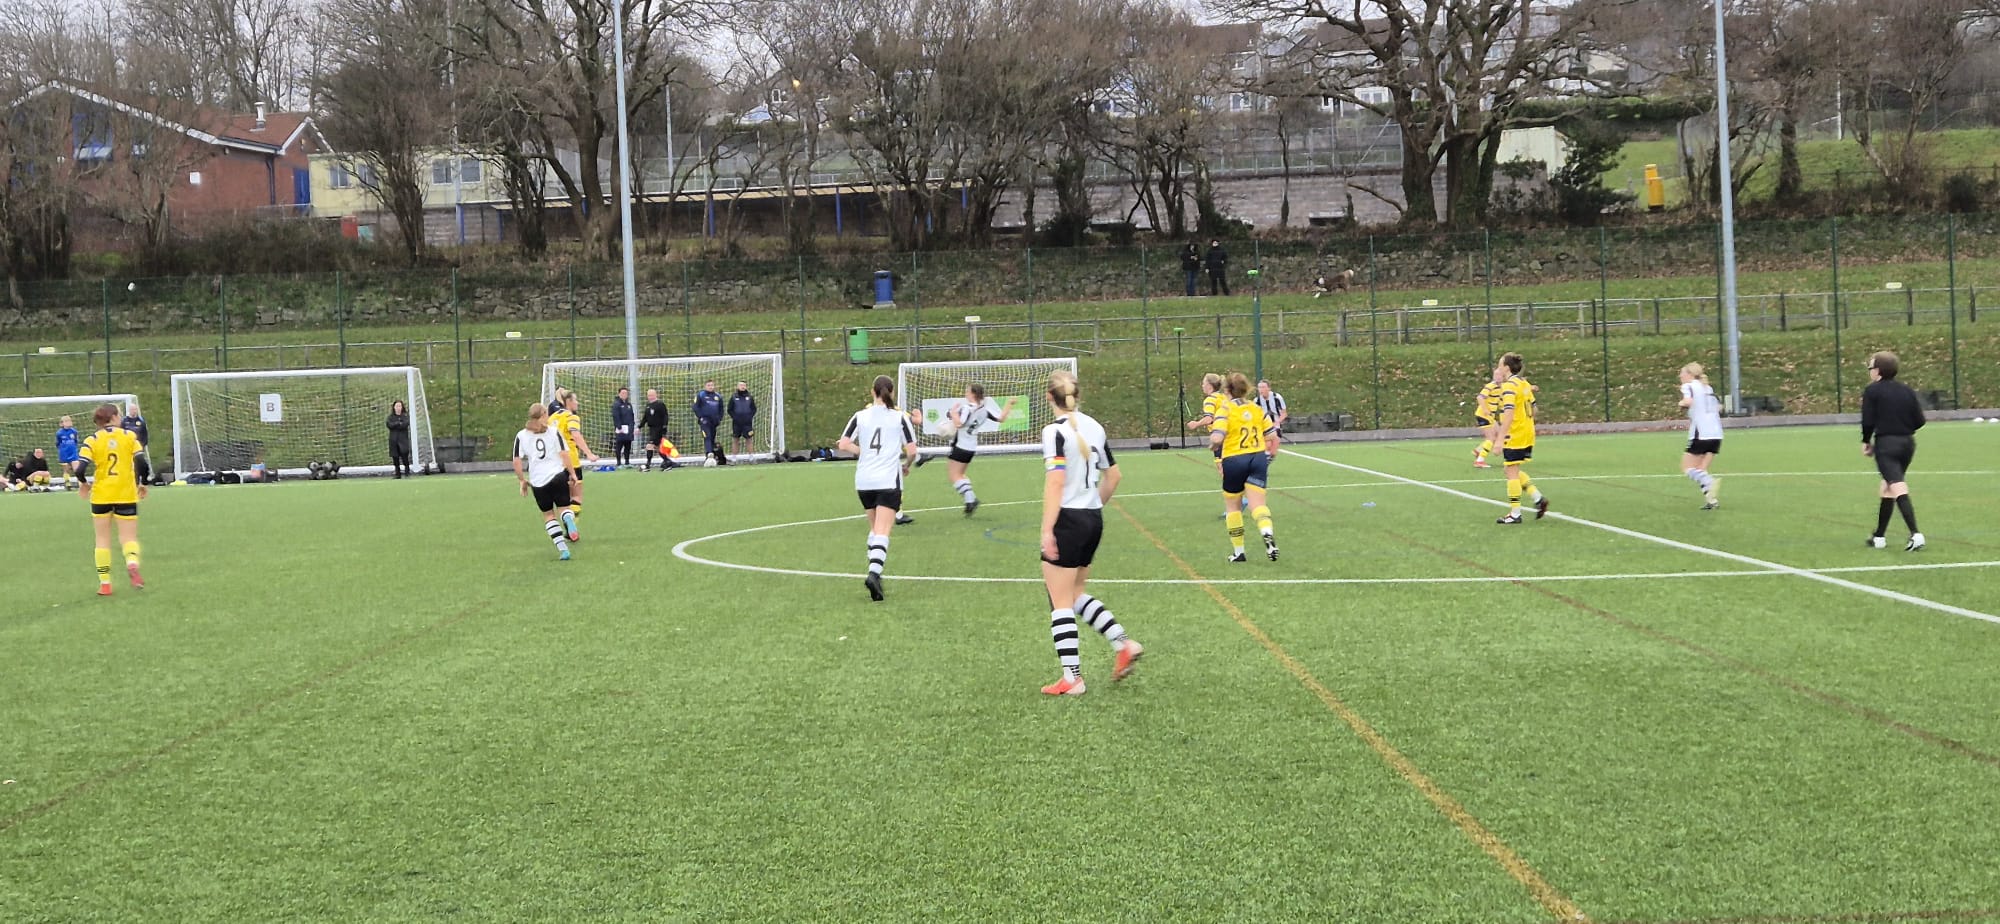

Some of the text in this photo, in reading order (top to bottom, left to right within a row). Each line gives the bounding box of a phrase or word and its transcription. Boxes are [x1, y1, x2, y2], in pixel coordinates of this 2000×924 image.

[869, 427, 882, 456] 4
[1239, 425, 1260, 449] 23
[535, 438, 546, 460] 9
[107, 453, 119, 476] 2
